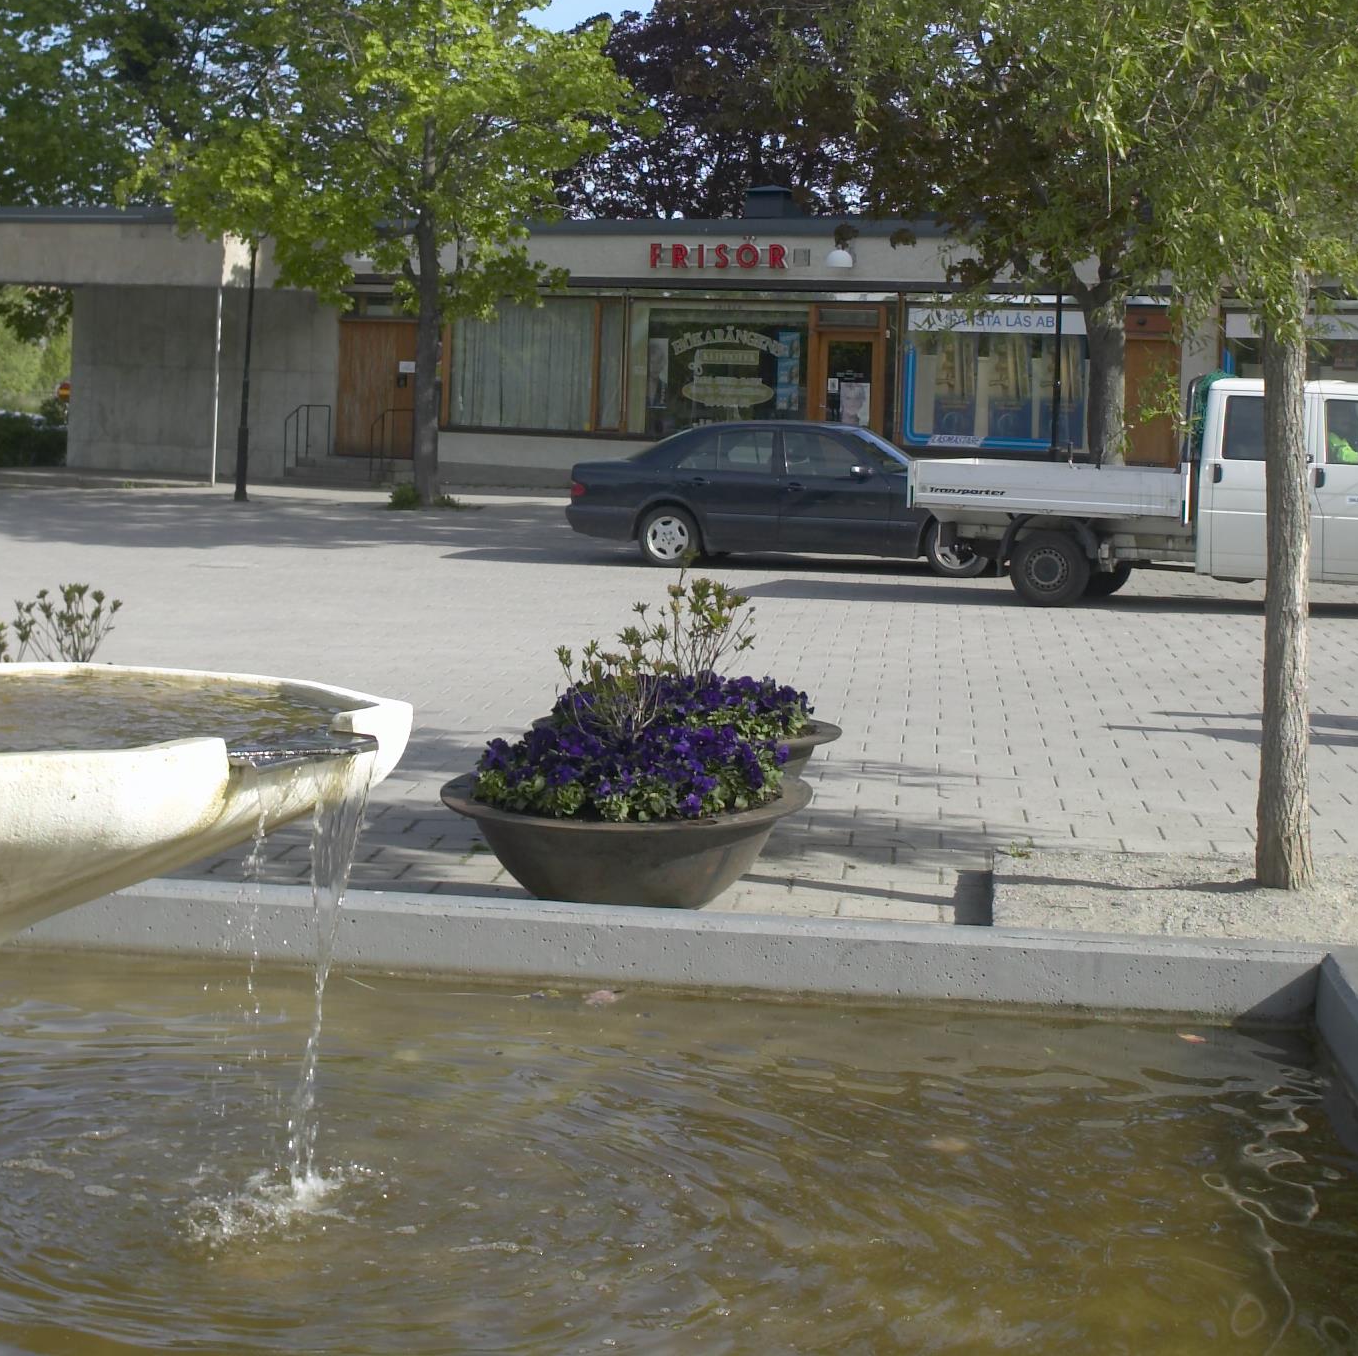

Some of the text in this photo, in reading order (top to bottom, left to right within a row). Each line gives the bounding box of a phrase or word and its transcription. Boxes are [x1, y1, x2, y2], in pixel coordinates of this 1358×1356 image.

[650, 236, 788, 269] FRISÖR
[1006, 312, 1031, 328] LÅS
[1036, 315, 1055, 328] AB
[929, 486, 1007, 496] Transporter
